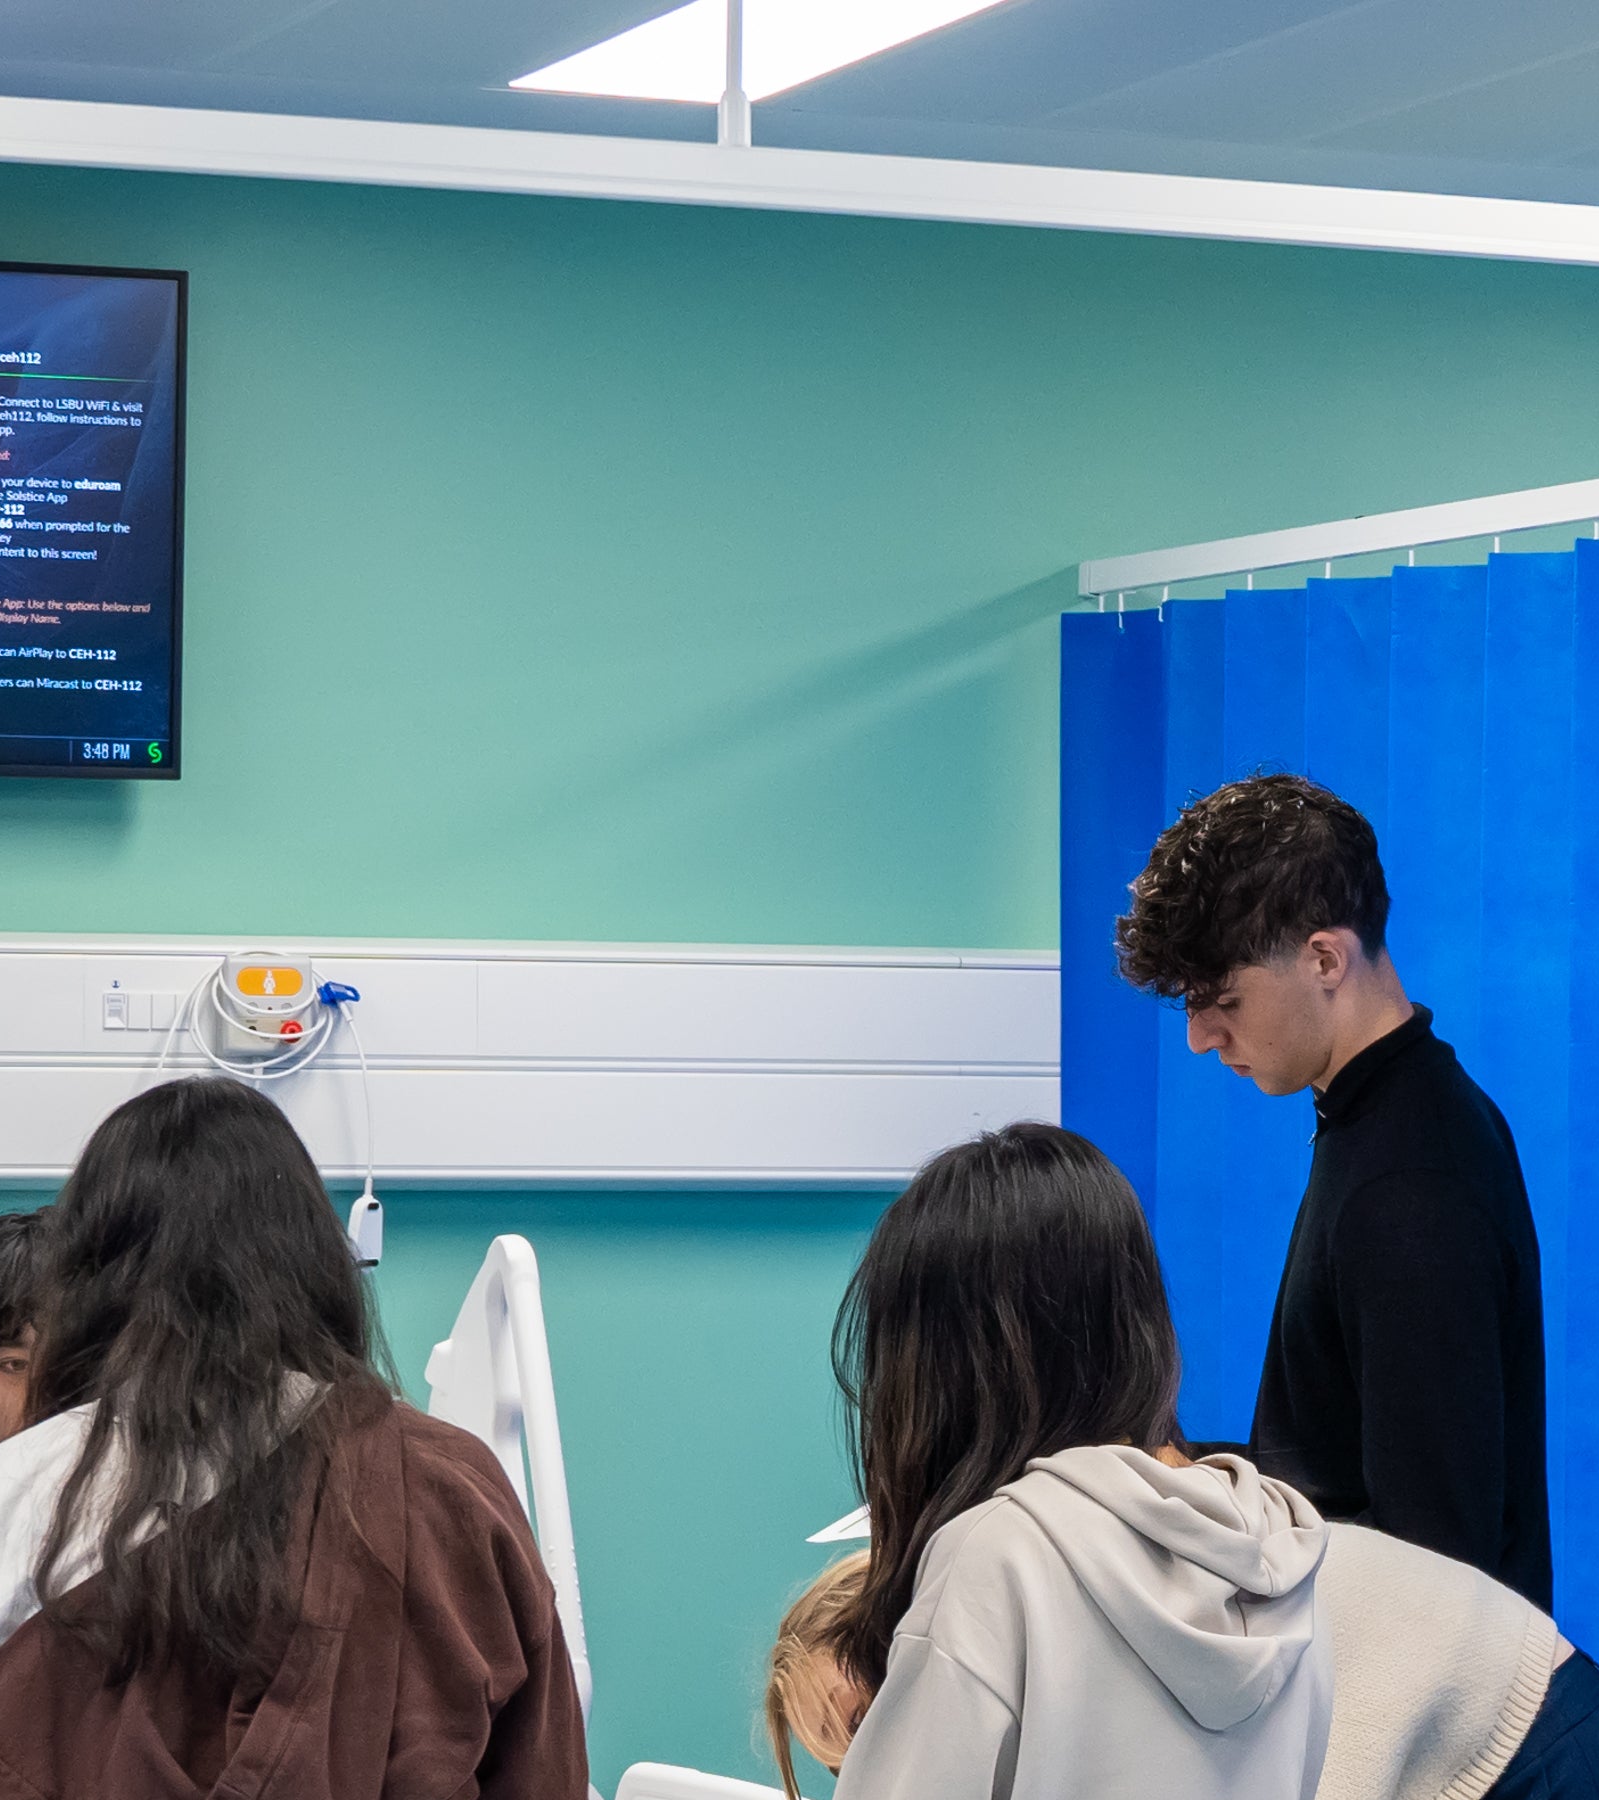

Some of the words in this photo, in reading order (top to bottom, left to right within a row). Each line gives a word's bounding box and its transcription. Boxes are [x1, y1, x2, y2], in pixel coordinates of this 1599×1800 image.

[42, 398, 53, 409] to
[56, 399, 83, 410] LSBU
[86, 400, 110, 411] WiFi
[112, 401, 120, 411] &
[122, 402, 143, 413] visit
[37, 412, 68, 424] follow
[70, 413, 128, 427] instructions
[130, 415, 141, 427] to
[1, 478, 25, 489] your
[27, 477, 59, 489] device
[61, 479, 72, 490] to
[74, 479, 121, 492] eduroam
[6, 490, 44, 502] Solstice
[46, 492, 68, 505] App
[15, 519, 43, 530] when
[45, 520, 94, 533] prompted
[96, 522, 111, 533] for
[113, 523, 130, 534] the
[27, 548, 38, 558] to
[41, 548, 59, 559] this
[61, 549, 98, 561] screen!
[27, 599, 46, 610] Use
[47, 600, 63, 611] the
[65, 600, 100, 613] options
[102, 602, 130, 613] below
[132, 603, 151, 614] and
[30, 613, 62, 624] Name.
[18, 647, 53, 660] AirPlay
[55, 649, 66, 659] to
[69, 649, 117, 661] CEH-112
[16, 679, 34, 689] can
[36, 677, 80, 690] Miracast
[82, 679, 93, 690] to
[94, 679, 142, 691] CEH-112
[83, 742, 109, 760] 3:48
[113, 743, 130, 760] PM
